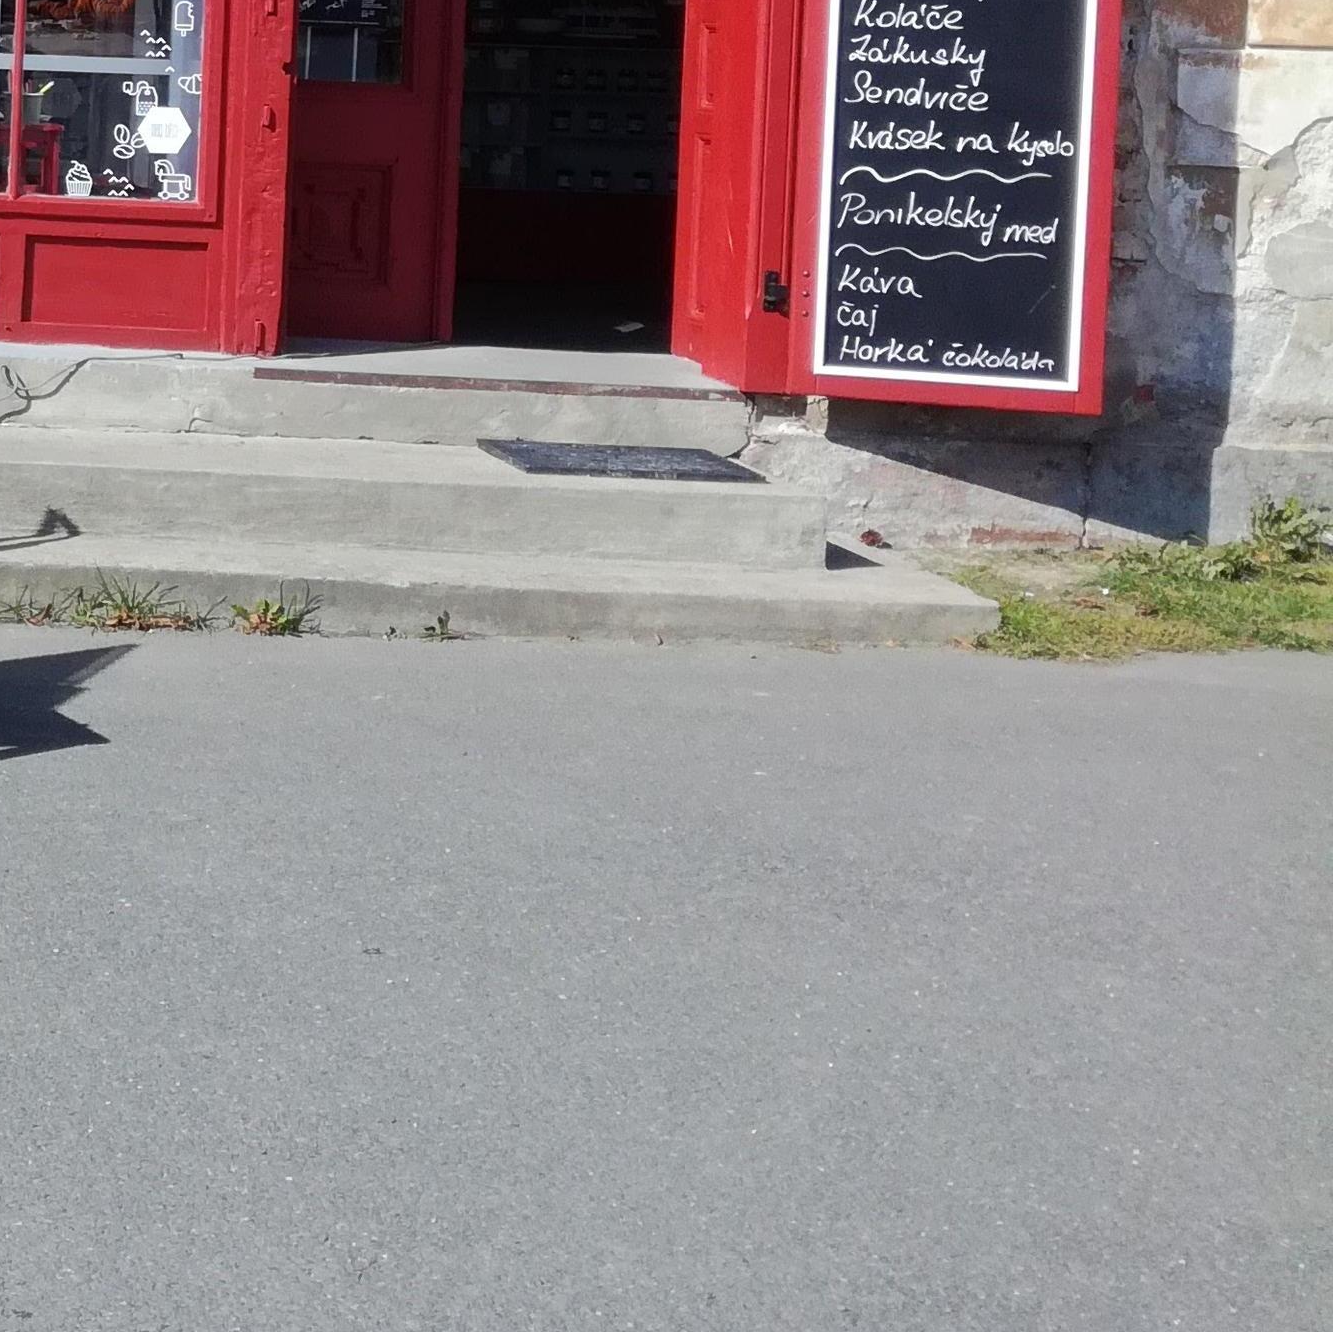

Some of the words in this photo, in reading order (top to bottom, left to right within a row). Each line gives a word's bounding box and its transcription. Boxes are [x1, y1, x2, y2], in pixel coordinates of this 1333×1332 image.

[848, 34, 986, 87] Zákusky
[844, 70, 989, 112] Sendviče
[849, 120, 946, 150] Kvásek
[956, 134, 1000, 153] na
[837, 191, 1002, 247] Ponikelský
[1003, 218, 1059, 244] med
[838, 264, 923, 299] Káva
[839, 335, 934, 363] Horká
[942, 342, 1055, 372] čokoláda
